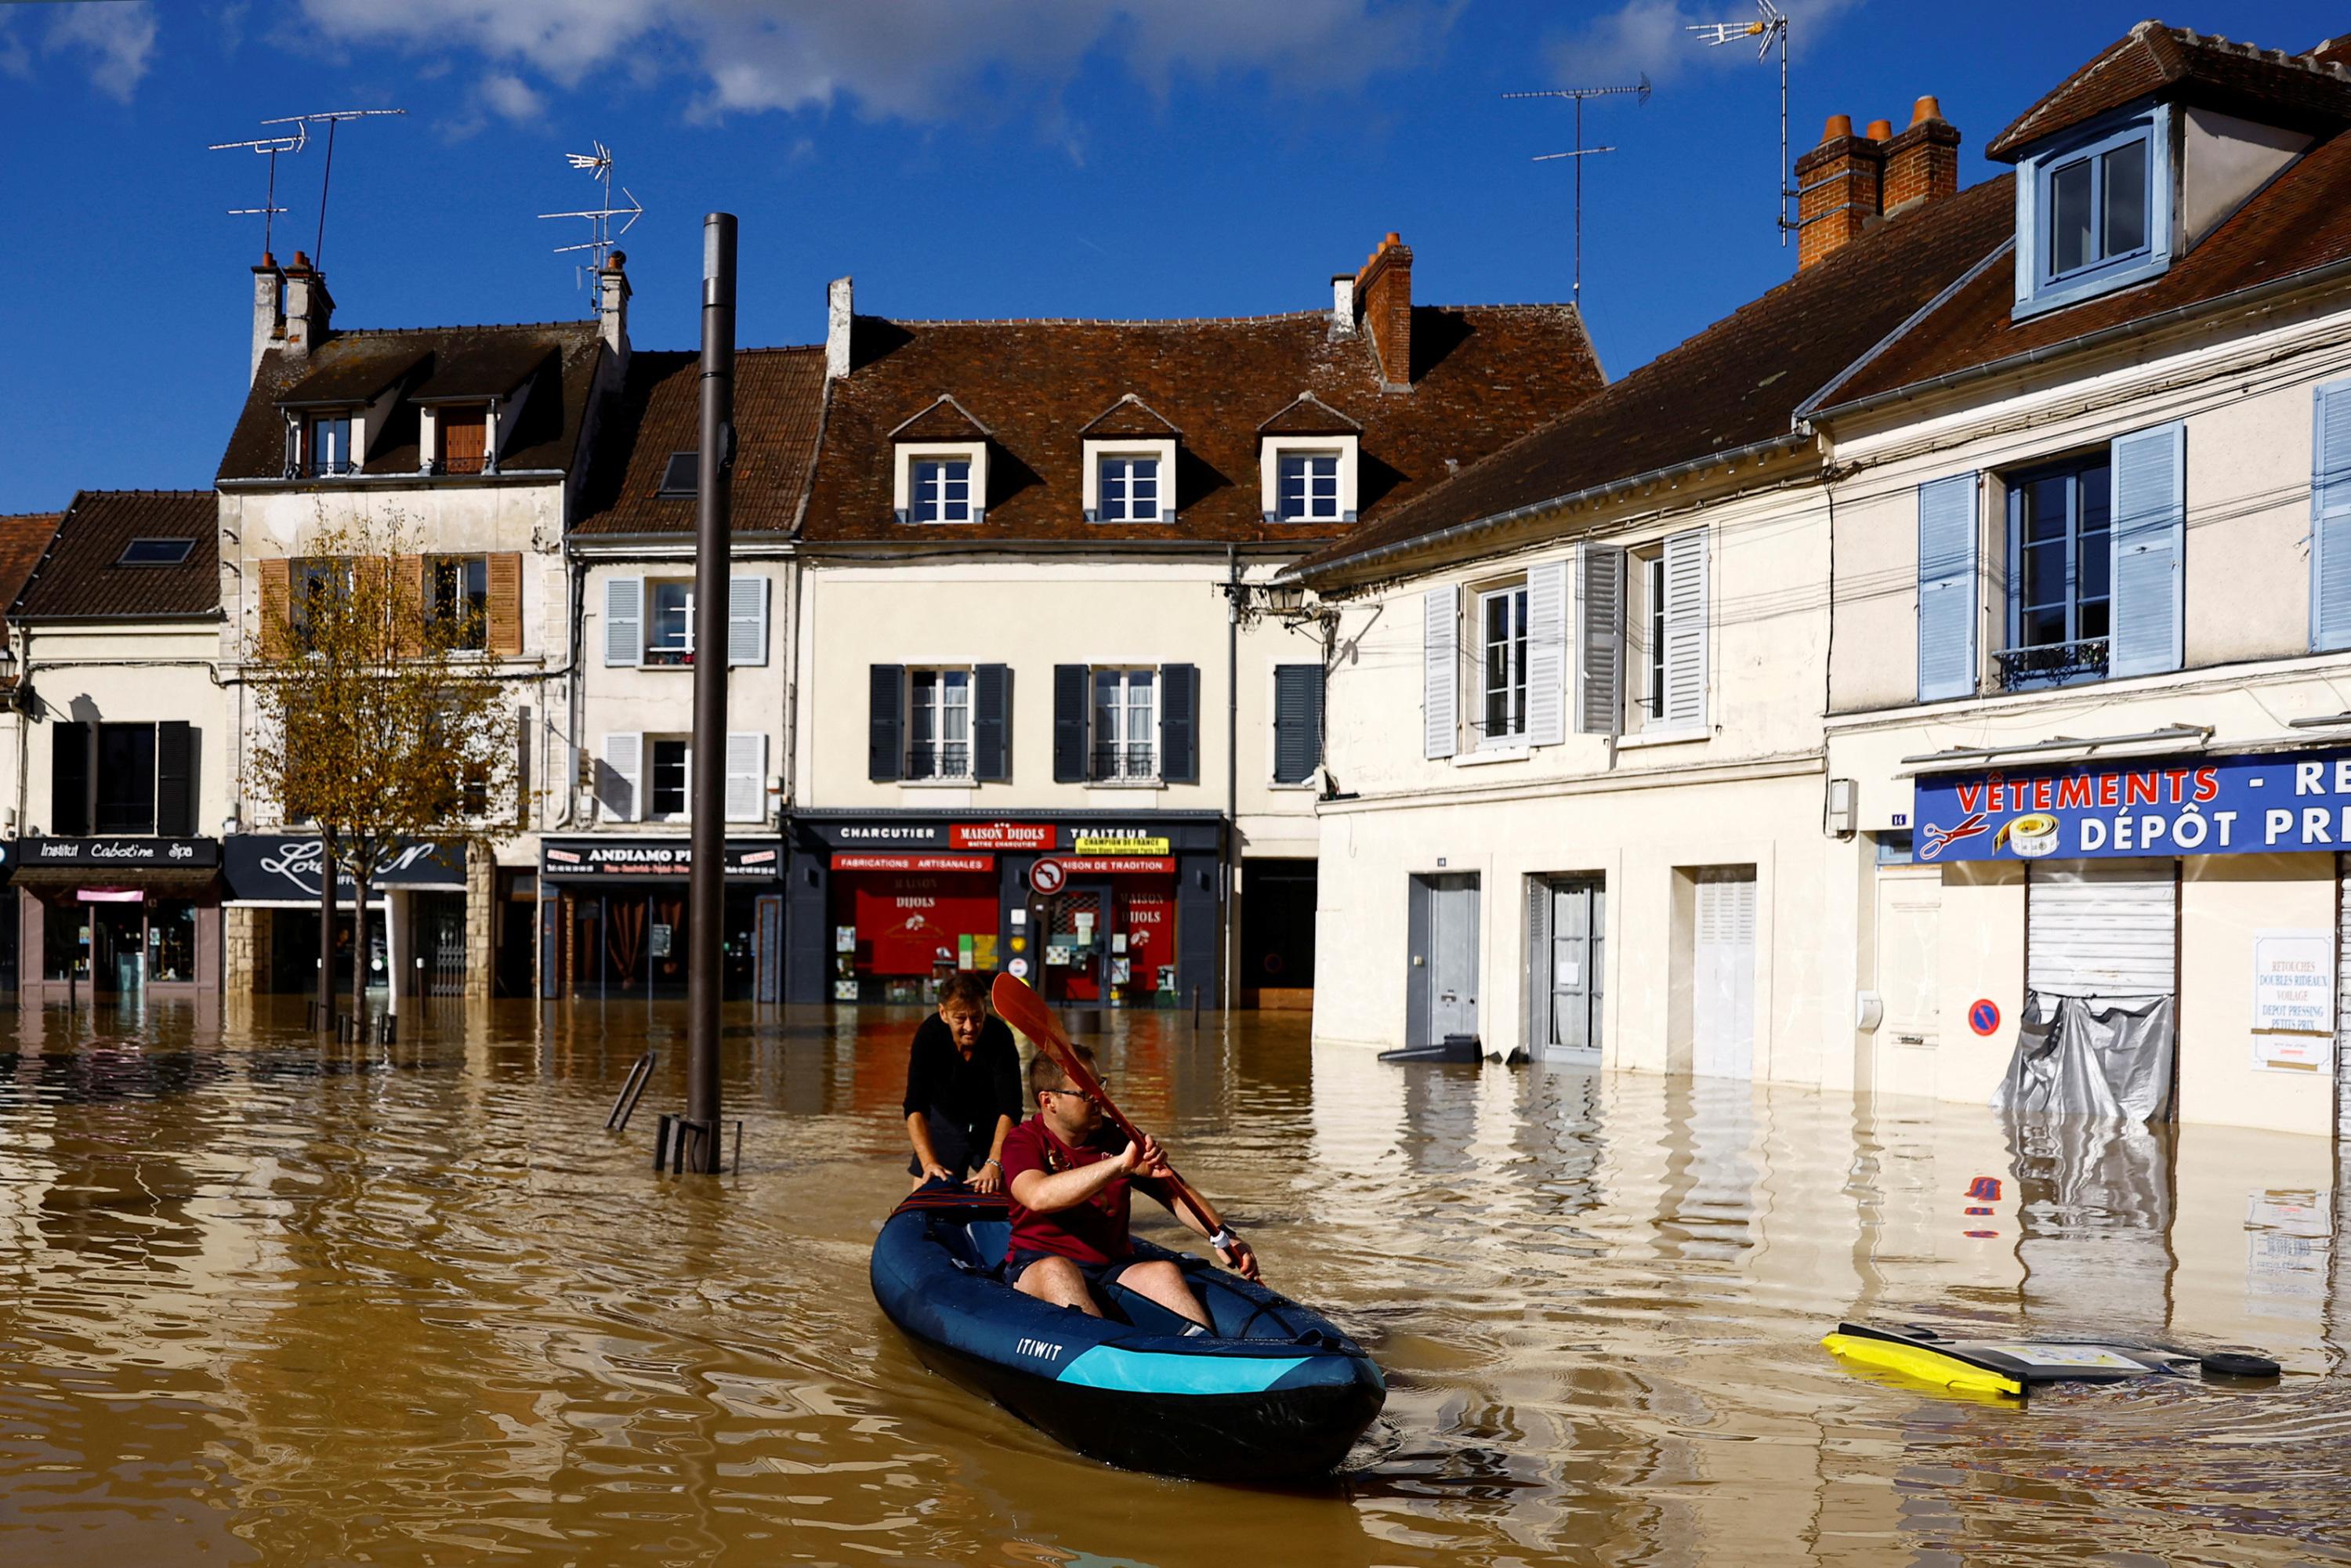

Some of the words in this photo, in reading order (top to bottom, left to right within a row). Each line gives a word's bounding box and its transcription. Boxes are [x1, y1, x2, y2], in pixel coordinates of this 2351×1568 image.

[1956, 765, 2219, 814] VÊTEMENTS
[2079, 801, 2237, 851] DÉPÔT
[840, 827, 935, 838] CHARCUTIER
[961, 827, 1002, 840] MAISON
[1007, 827, 1045, 841] DIJOLS
[1070, 828, 1147, 838] TRAITEUR
[41, 842, 78, 856] Institut
[90, 842, 155, 857] Cabotine
[168, 842, 193, 860] Spa
[589, 849, 672, 862] ANDIAMO
[840, 858, 909, 868] FABRICATIONS
[918, 860, 983, 870] ARTISANALES
[1061, 862, 1092, 871] AISON
[1094, 862, 1107, 871] DE
[1111, 862, 1163, 871] TRADITION
[896, 896, 936, 908] DIJOLS
[2272, 961, 2316, 972] RETOUCHES
[2259, 975, 2293, 987] DOUBLES
[2295, 975, 2327, 987] RIDEAUX
[2276, 990, 2309, 1001] VOILAGE
[2288, 1005, 2324, 1017] PRESSING
[2271, 1019, 2295, 1030] PETITS
[2297, 1019, 2315, 1031] PRIX
[1016, 1338, 1063, 1361] ITIWIT
